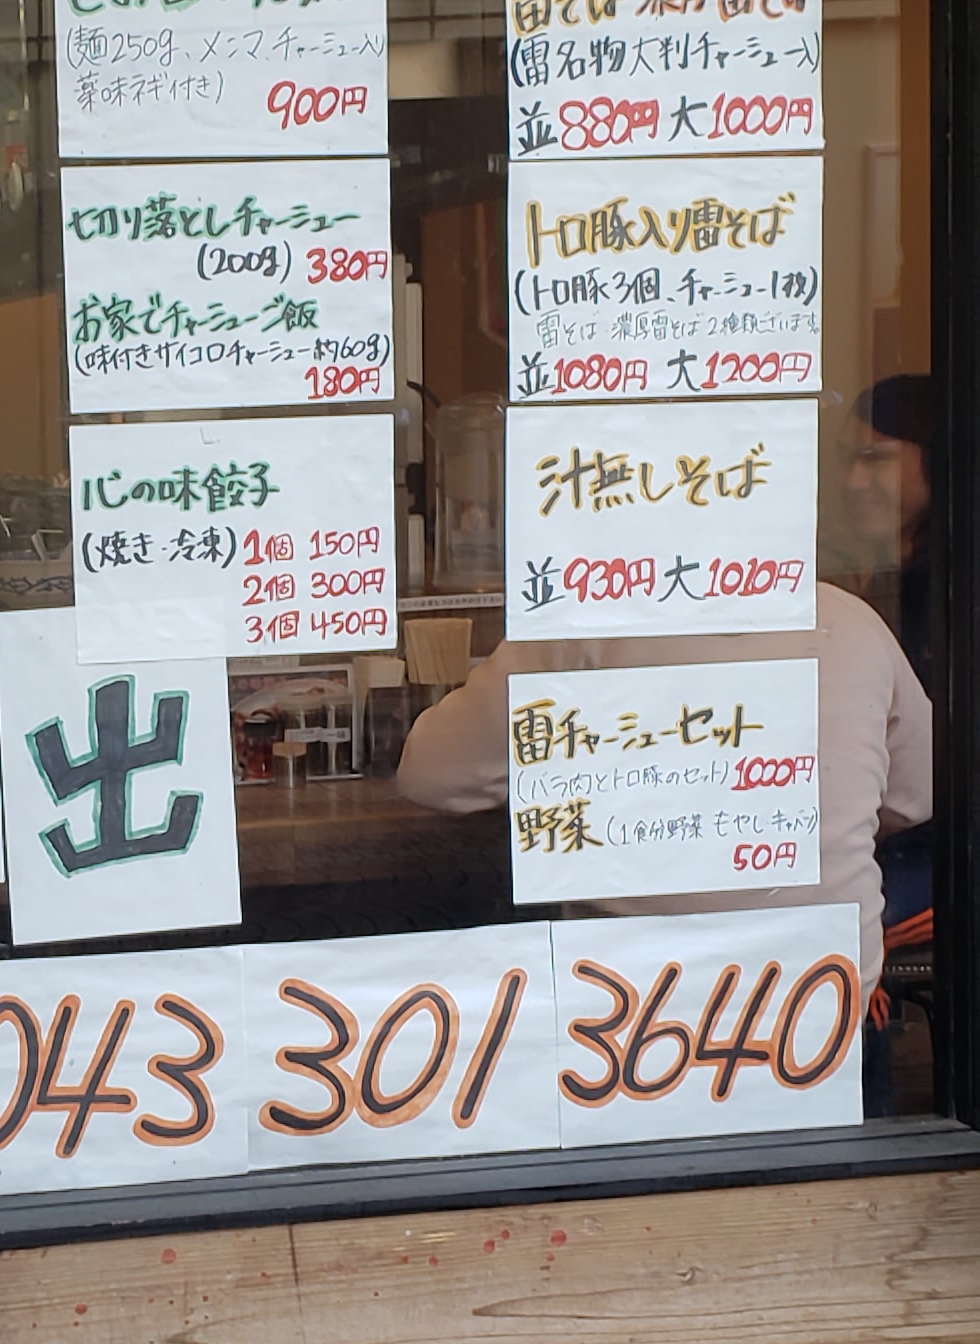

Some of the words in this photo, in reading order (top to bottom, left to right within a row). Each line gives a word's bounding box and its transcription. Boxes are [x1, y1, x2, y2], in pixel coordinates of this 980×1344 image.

[267, 81, 368, 130] 900円
[66, 191, 362, 241] 切り落としチャーシュー
[526, 191, 798, 269] トロ豚入り雷そば
[197, 241, 292, 284] (200g)
[306, 248, 388, 284] 380円
[304, 366, 380, 399] 180円
[81, 460, 280, 512] 心の味餃子
[535, 441, 773, 517] 汁無しそば
[243, 530, 294, 565] 1個
[309, 527, 380, 560] 150円
[242, 573, 295, 606] 2個
[311, 568, 385, 600] 300円
[245, 610, 300, 643] 3個
[310, 608, 387, 640] 450円
[511, 698, 765, 766] 雷チャーシューセット
[26, 673, 206, 879] 出
[731, 755, 816, 791] 1000円
[514, 798, 603, 854] 野菜
[732, 842, 797, 871] 50円
[260, 967, 530, 1132] 301
[558, 954, 863, 1108] 3640
